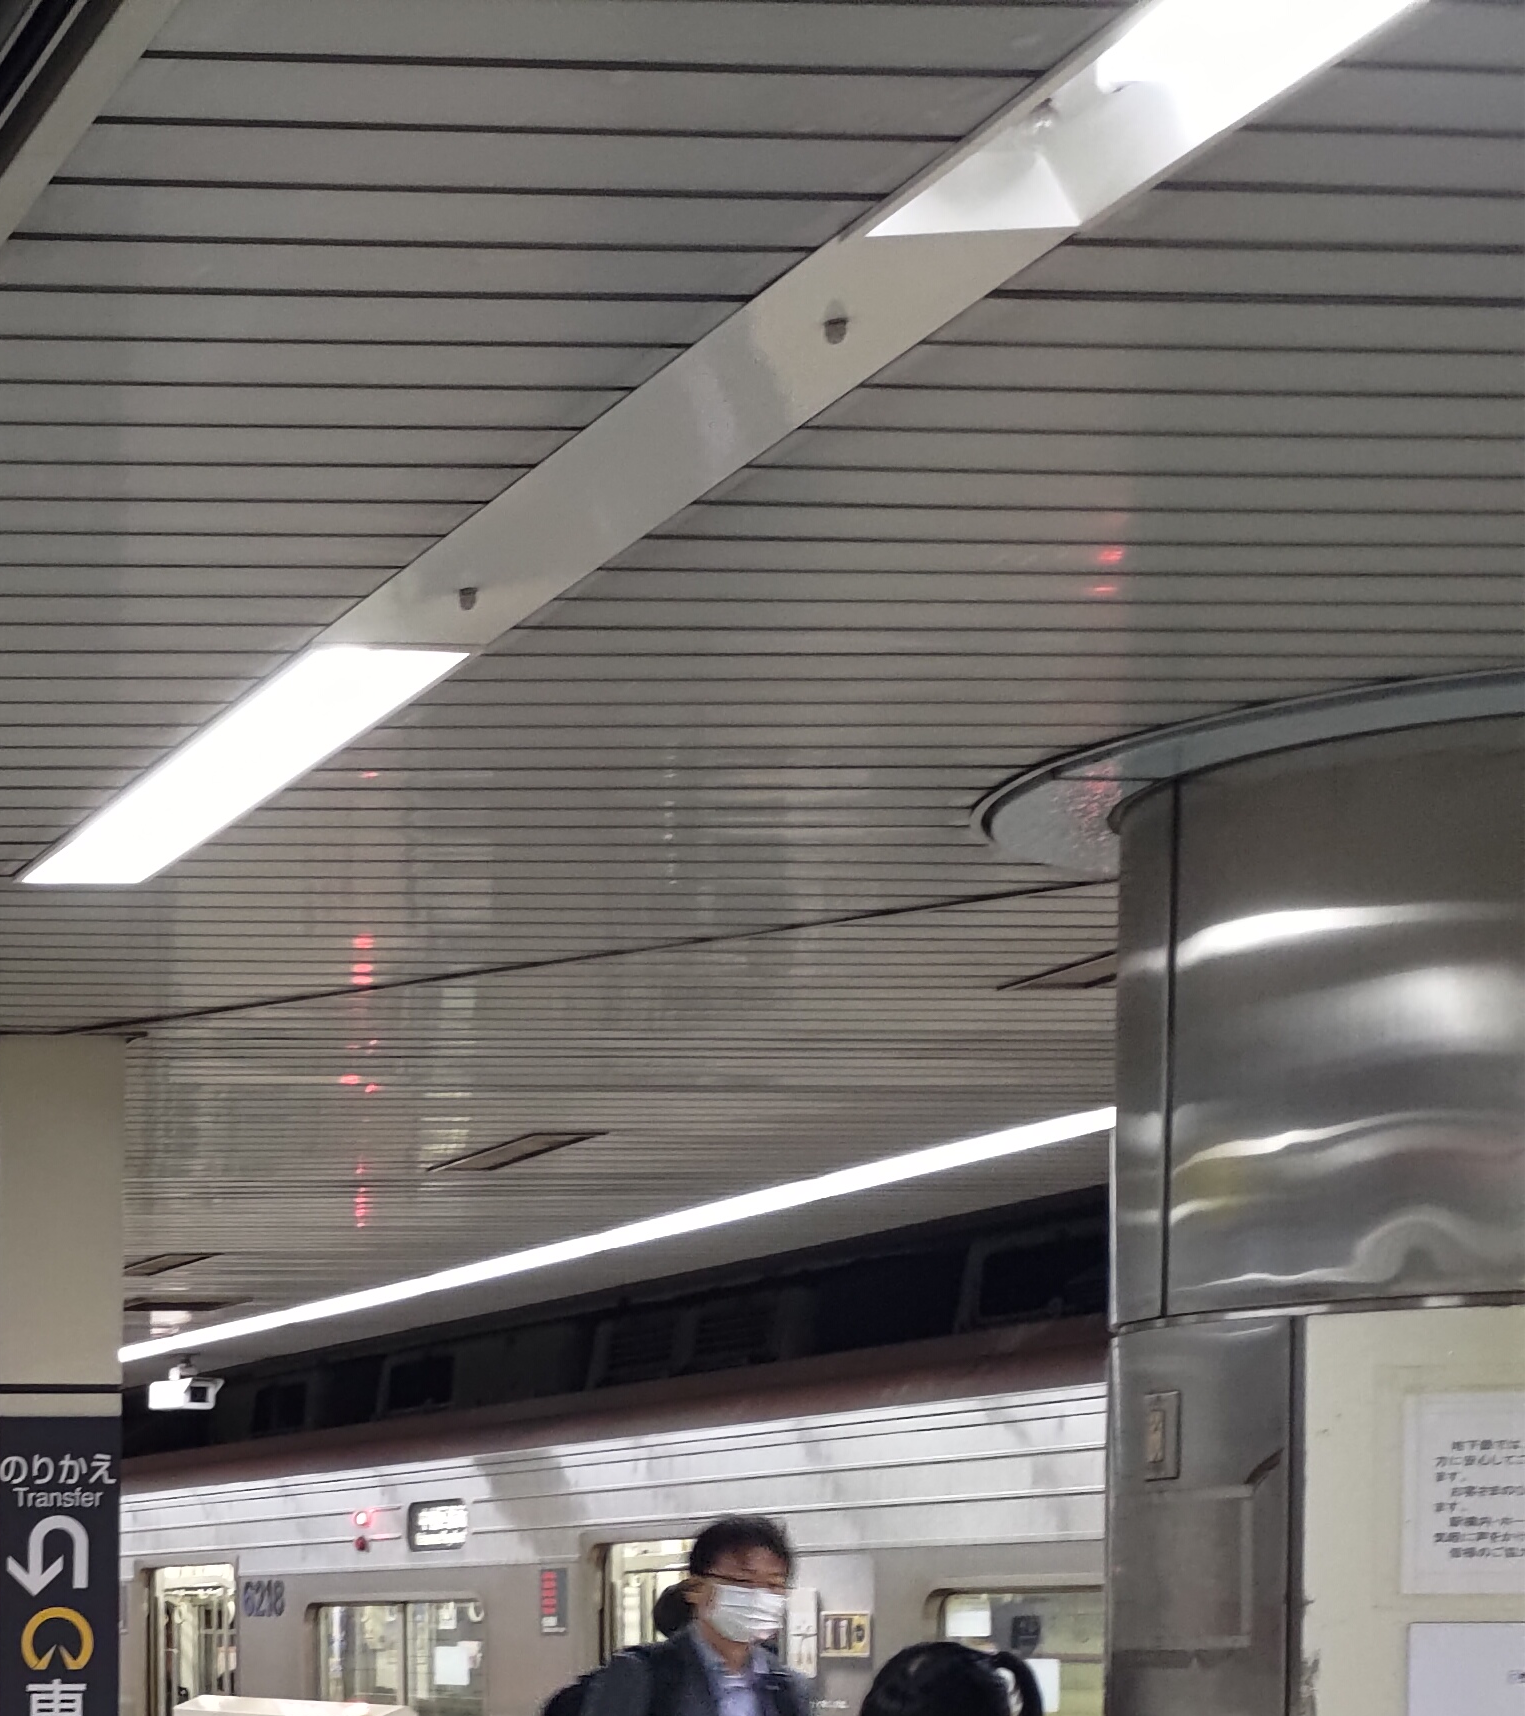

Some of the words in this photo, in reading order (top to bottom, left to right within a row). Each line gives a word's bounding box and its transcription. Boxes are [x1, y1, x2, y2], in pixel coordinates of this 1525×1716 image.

[0, 1453, 117, 1485] のりかえ
[12, 1487, 104, 1508] Transfer
[243, 1579, 286, 1618] 6218
